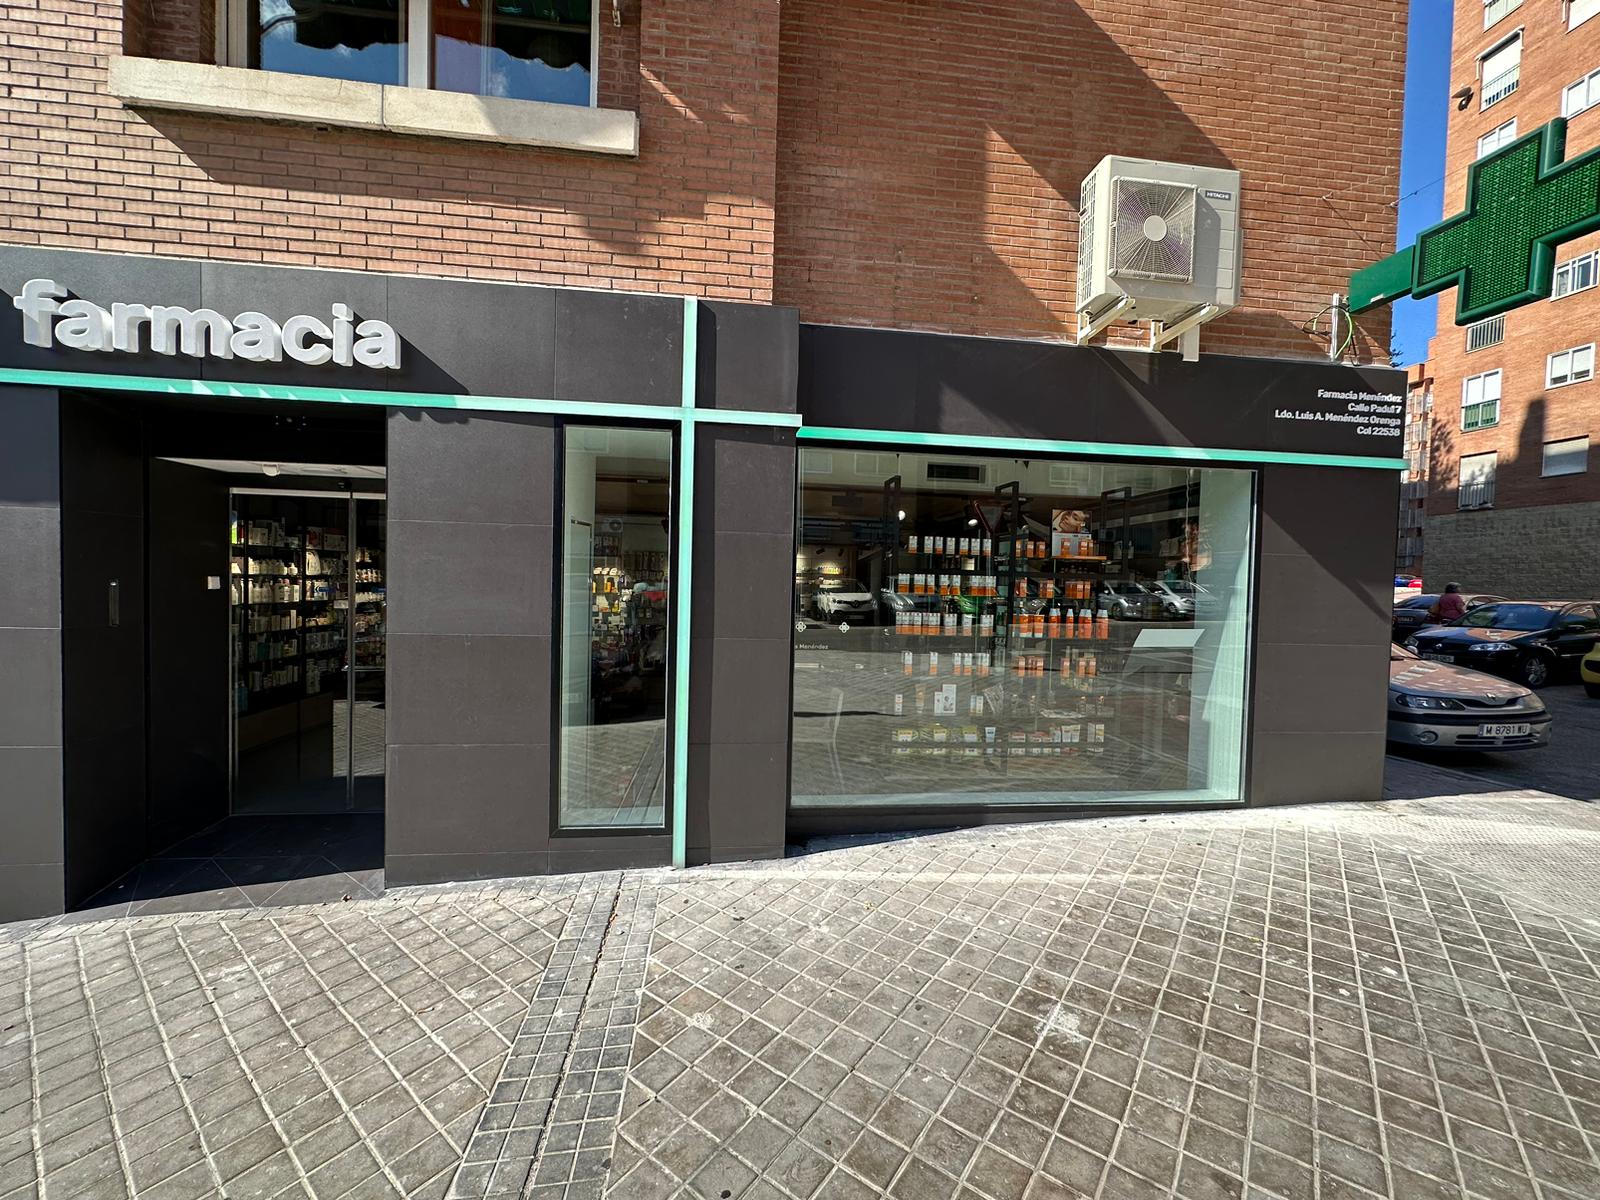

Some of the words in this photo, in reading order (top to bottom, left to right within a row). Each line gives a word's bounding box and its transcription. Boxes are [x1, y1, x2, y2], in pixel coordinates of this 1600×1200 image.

[1206, 191, 1230, 199] HITACHI
[13, 278, 402, 370] farmacia
[1317, 389, 1358, 400] Farmacia
[1358, 391, 1403, 403] Menéndez
[1347, 402, 1370, 412] Calle
[1395, 405, 1402, 414] 7
[1274, 409, 1294, 419] Ldo.
[1295, 410, 1314, 421] Luis
[1314, 412, 1325, 421] A.
[1324, 412, 1369, 424] Menéndez
[1369, 416, 1401, 426] Orenga
[1356, 426, 1372, 436] Col
[1372, 427, 1401, 437] 22538
[1486, 725, 1493, 735] M
